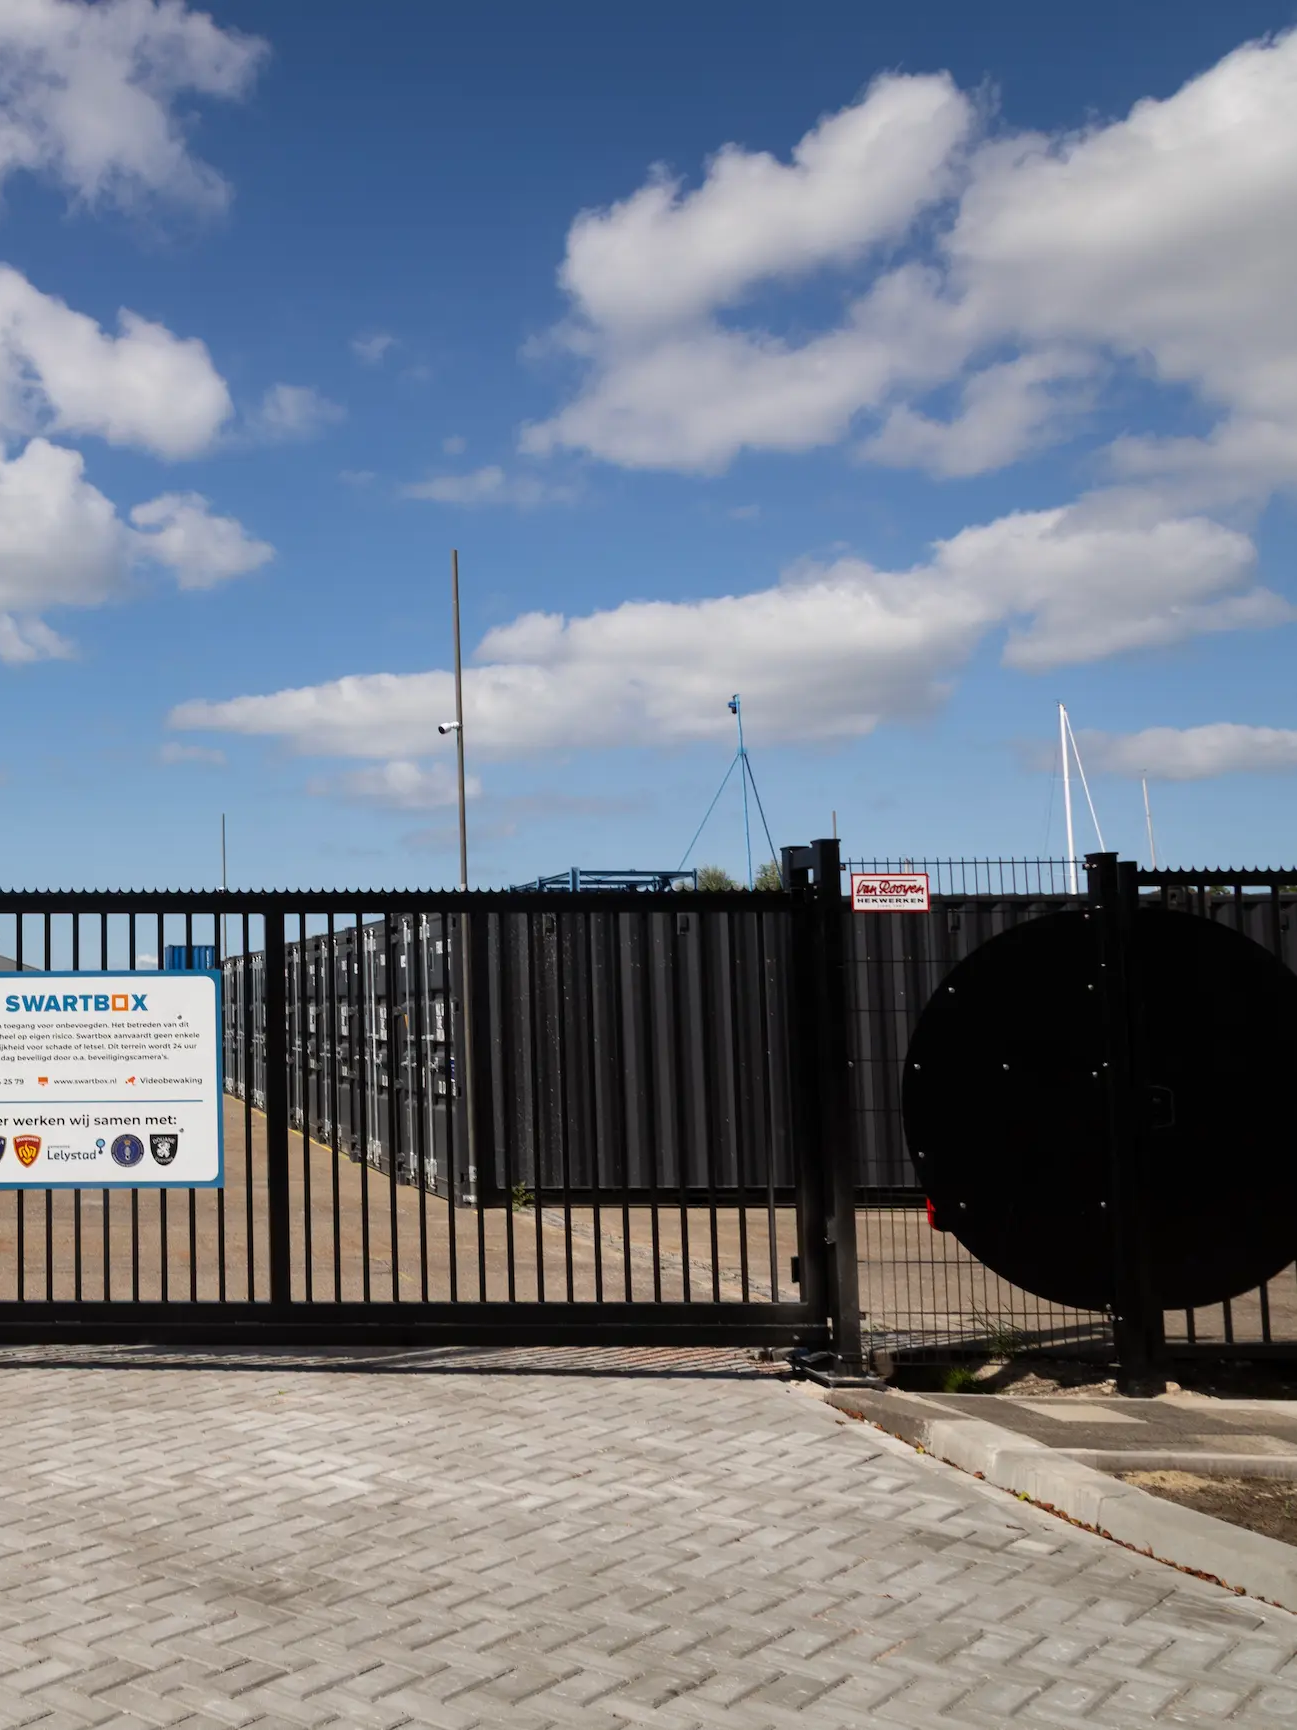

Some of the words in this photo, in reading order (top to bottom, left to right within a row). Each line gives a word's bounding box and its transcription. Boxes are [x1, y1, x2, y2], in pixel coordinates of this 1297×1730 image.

[5, 993, 149, 1012] SWARTBOX
[3, 1023, 35, 1031] toegang
[55, 1022, 110, 1030] onbevoegden.
[111, 1021, 125, 1029] Het
[127, 1021, 162, 1029] betreden
[179, 1020, 189, 1028] dit
[17, 1034, 28, 1042] op
[29, 1033, 51, 1041] eigen
[52, 1032, 75, 1040] risico.
[76, 1032, 112, 1040] Swartbox
[153, 1032, 173, 1040] geen
[174, 1031, 200, 1039] enkele
[45, 1043, 73, 1051] schade
[107, 1042, 119, 1050] Dit
[120, 1042, 146, 1050] terrein
[148, 1042, 171, 1050] wordt
[0, 1054, 15, 1063] dag
[17, 1054, 52, 1062] beveiligd
[87, 1053, 170, 1062] beveiligingscamera's.
[3, 1078, 13, 1086] 25
[14, 1078, 25, 1086] 79
[53, 1077, 118, 1085] www.swartbox.nl
[140, 1076, 203, 1086] Videobewaking
[12, 1115, 66, 1126] werken
[69, 1114, 90, 1128] wij
[93, 1117, 141, 1126] samen
[145, 1115, 177, 1125] met:
[47, 1149, 97, 1162] Lelystad
